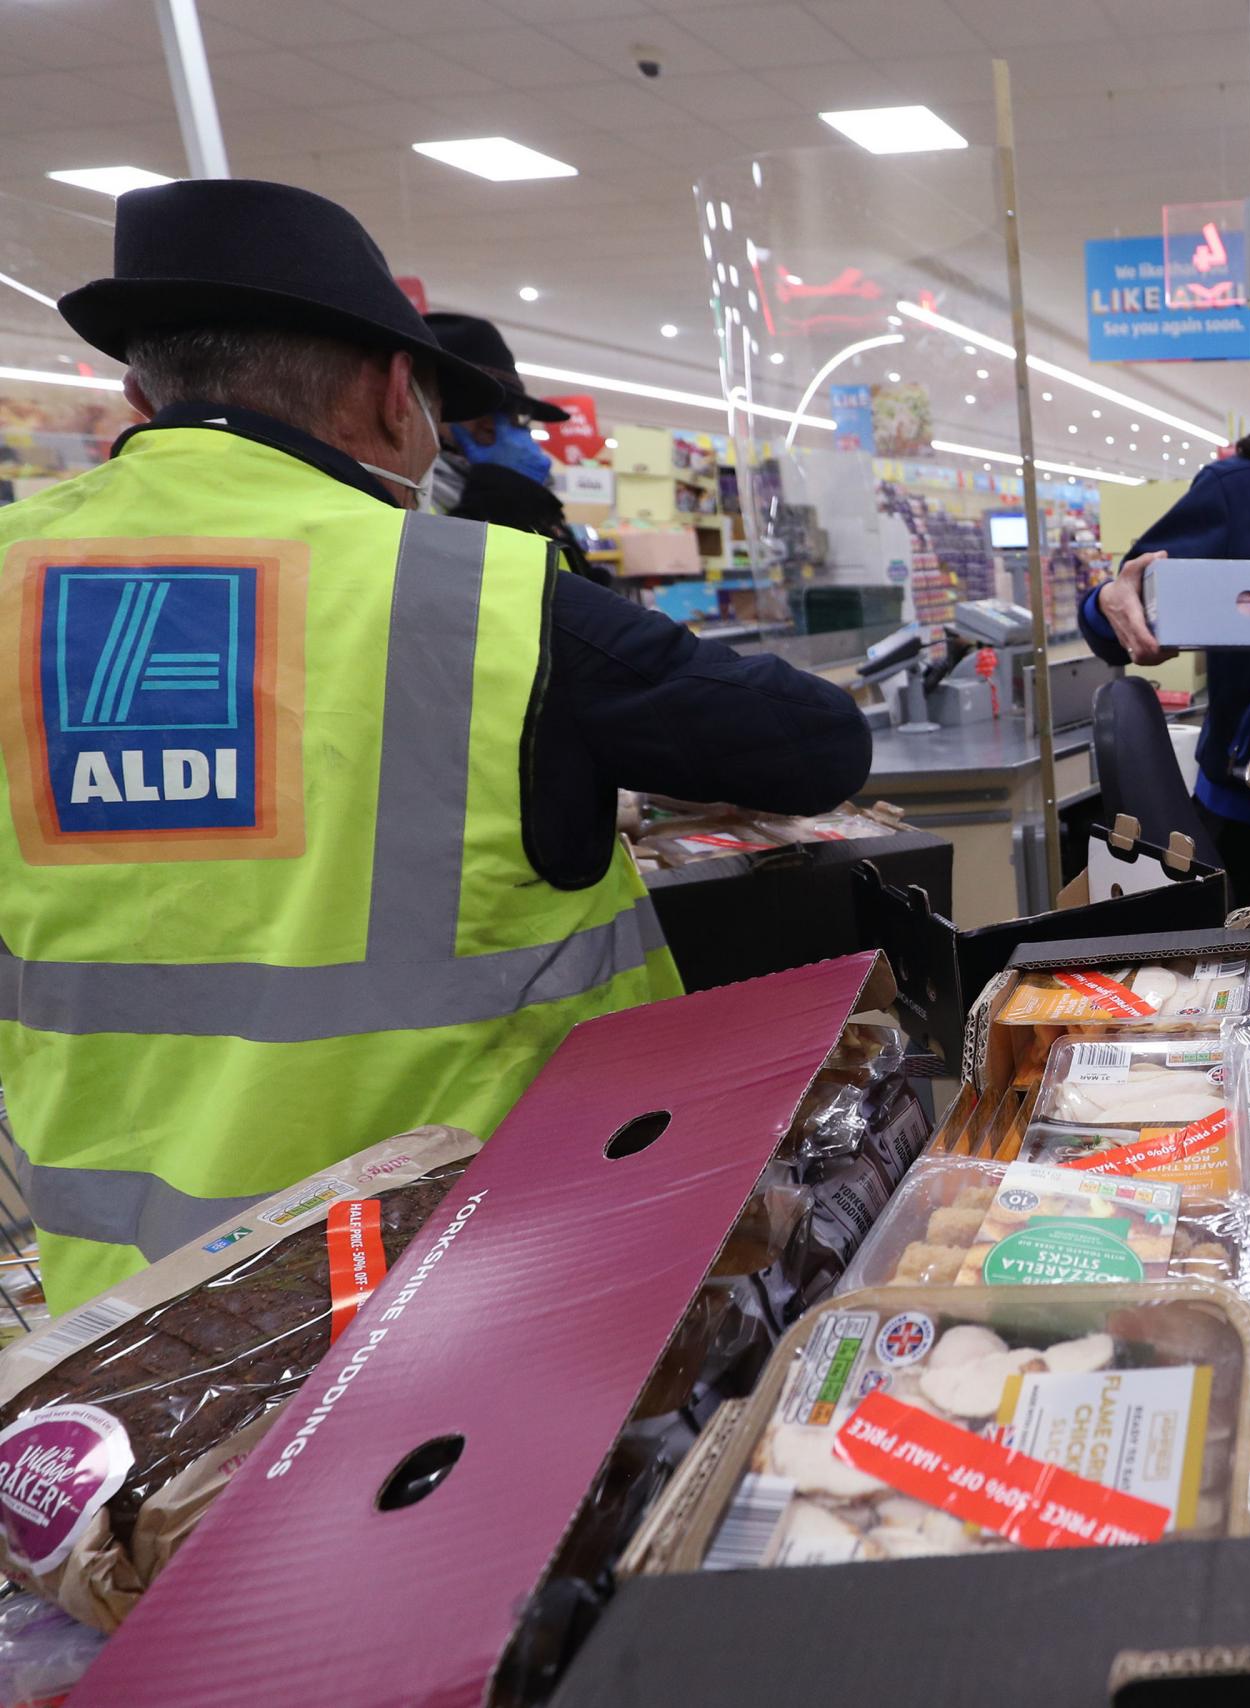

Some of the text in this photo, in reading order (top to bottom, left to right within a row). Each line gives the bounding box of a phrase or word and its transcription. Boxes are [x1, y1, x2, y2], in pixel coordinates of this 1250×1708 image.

[1114, 265, 1136, 280] We
[1138, 262, 1163, 279] like
[1091, 286, 1161, 315] LIKE
[1103, 317, 1246, 339] See you again soon.
[70, 749, 238, 804] ALDI
[1110, 993, 1128, 1009] PRICE
[1124, 1153, 1146, 1166] OFF
[1147, 1144, 1177, 1158] 50%
[1183, 1160, 1229, 1171] WAFER
[831, 1190, 867, 1236] PUDDINGS
[837, 1182, 874, 1230] YORKSHIRE
[1009, 1196, 1028, 1206] 10
[350, 1203, 362, 1229] HALF
[1149, 1213, 1165, 1223] V
[351, 1229, 363, 1248] PRICE
[1017, 1239, 1033, 1247] DIP
[352, 1251, 366, 1272] 50%
[380, 1189, 489, 1322] YORKSHIRE
[1036, 1250, 1101, 1270] STICKS
[355, 1272, 368, 1285] OFF
[266, 1327, 388, 1480] PUDDINGS
[1094, 1375, 1122, 1440] FLAME
[846, 1417, 898, 1453] PRICE
[1044, 1417, 1067, 1458] SLIC
[1131, 1405, 1144, 1444] READY
[1067, 1404, 1093, 1475] CHICK
[15, 1444, 78, 1486] Village
[893, 1440, 942, 1473] HALF
[1127, 1449, 1137, 1466] TO
[0, 1461, 73, 1518] BAKERY
[947, 1464, 985, 1492] OFF
[985, 1478, 1032, 1510] 50%
[1039, 1502, 1098, 1538] PRICE
